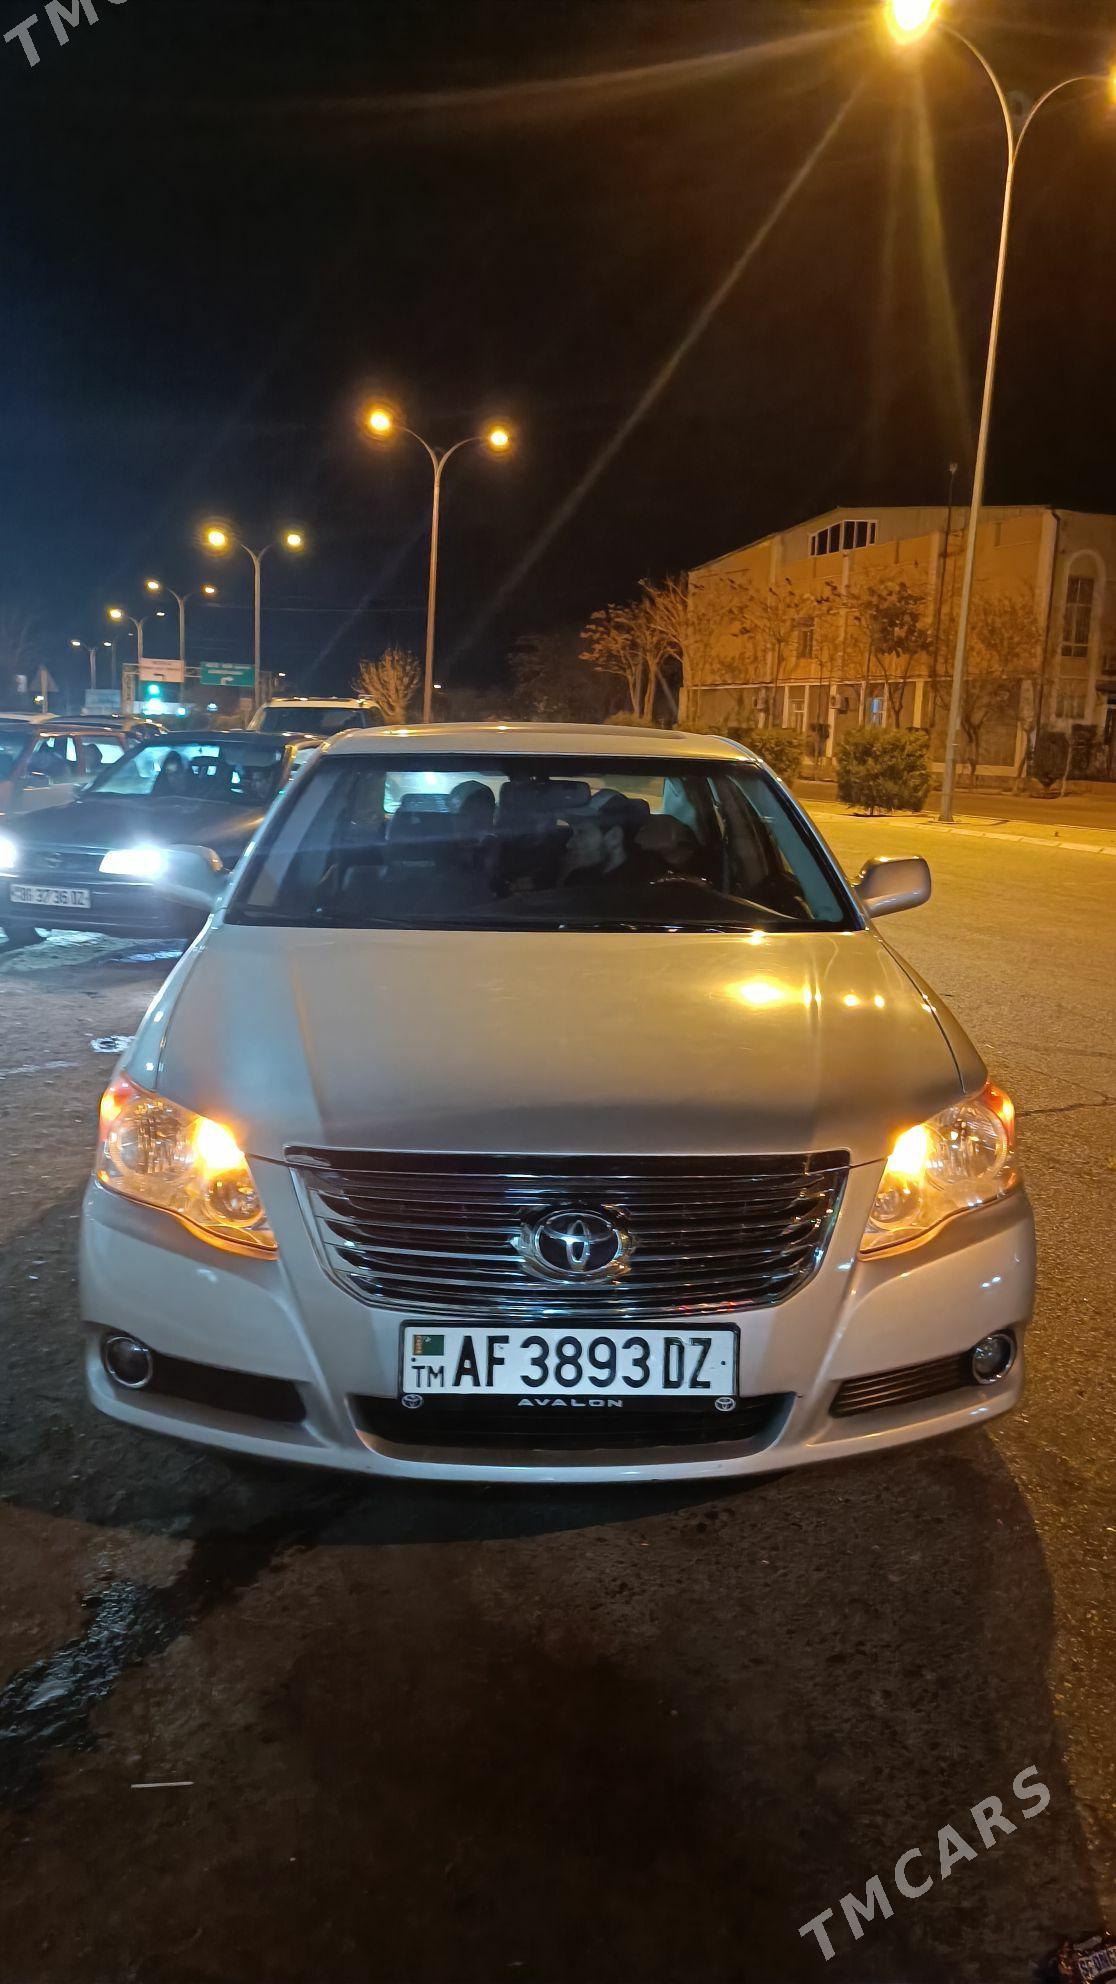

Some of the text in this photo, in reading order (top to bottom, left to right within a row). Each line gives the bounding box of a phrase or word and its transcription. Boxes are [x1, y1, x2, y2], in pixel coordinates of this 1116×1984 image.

[452, 1335, 713, 1389] AF 3893 DZ
[411, 1365, 445, 1388] TM
[517, 1398, 624, 1408] AVALON
